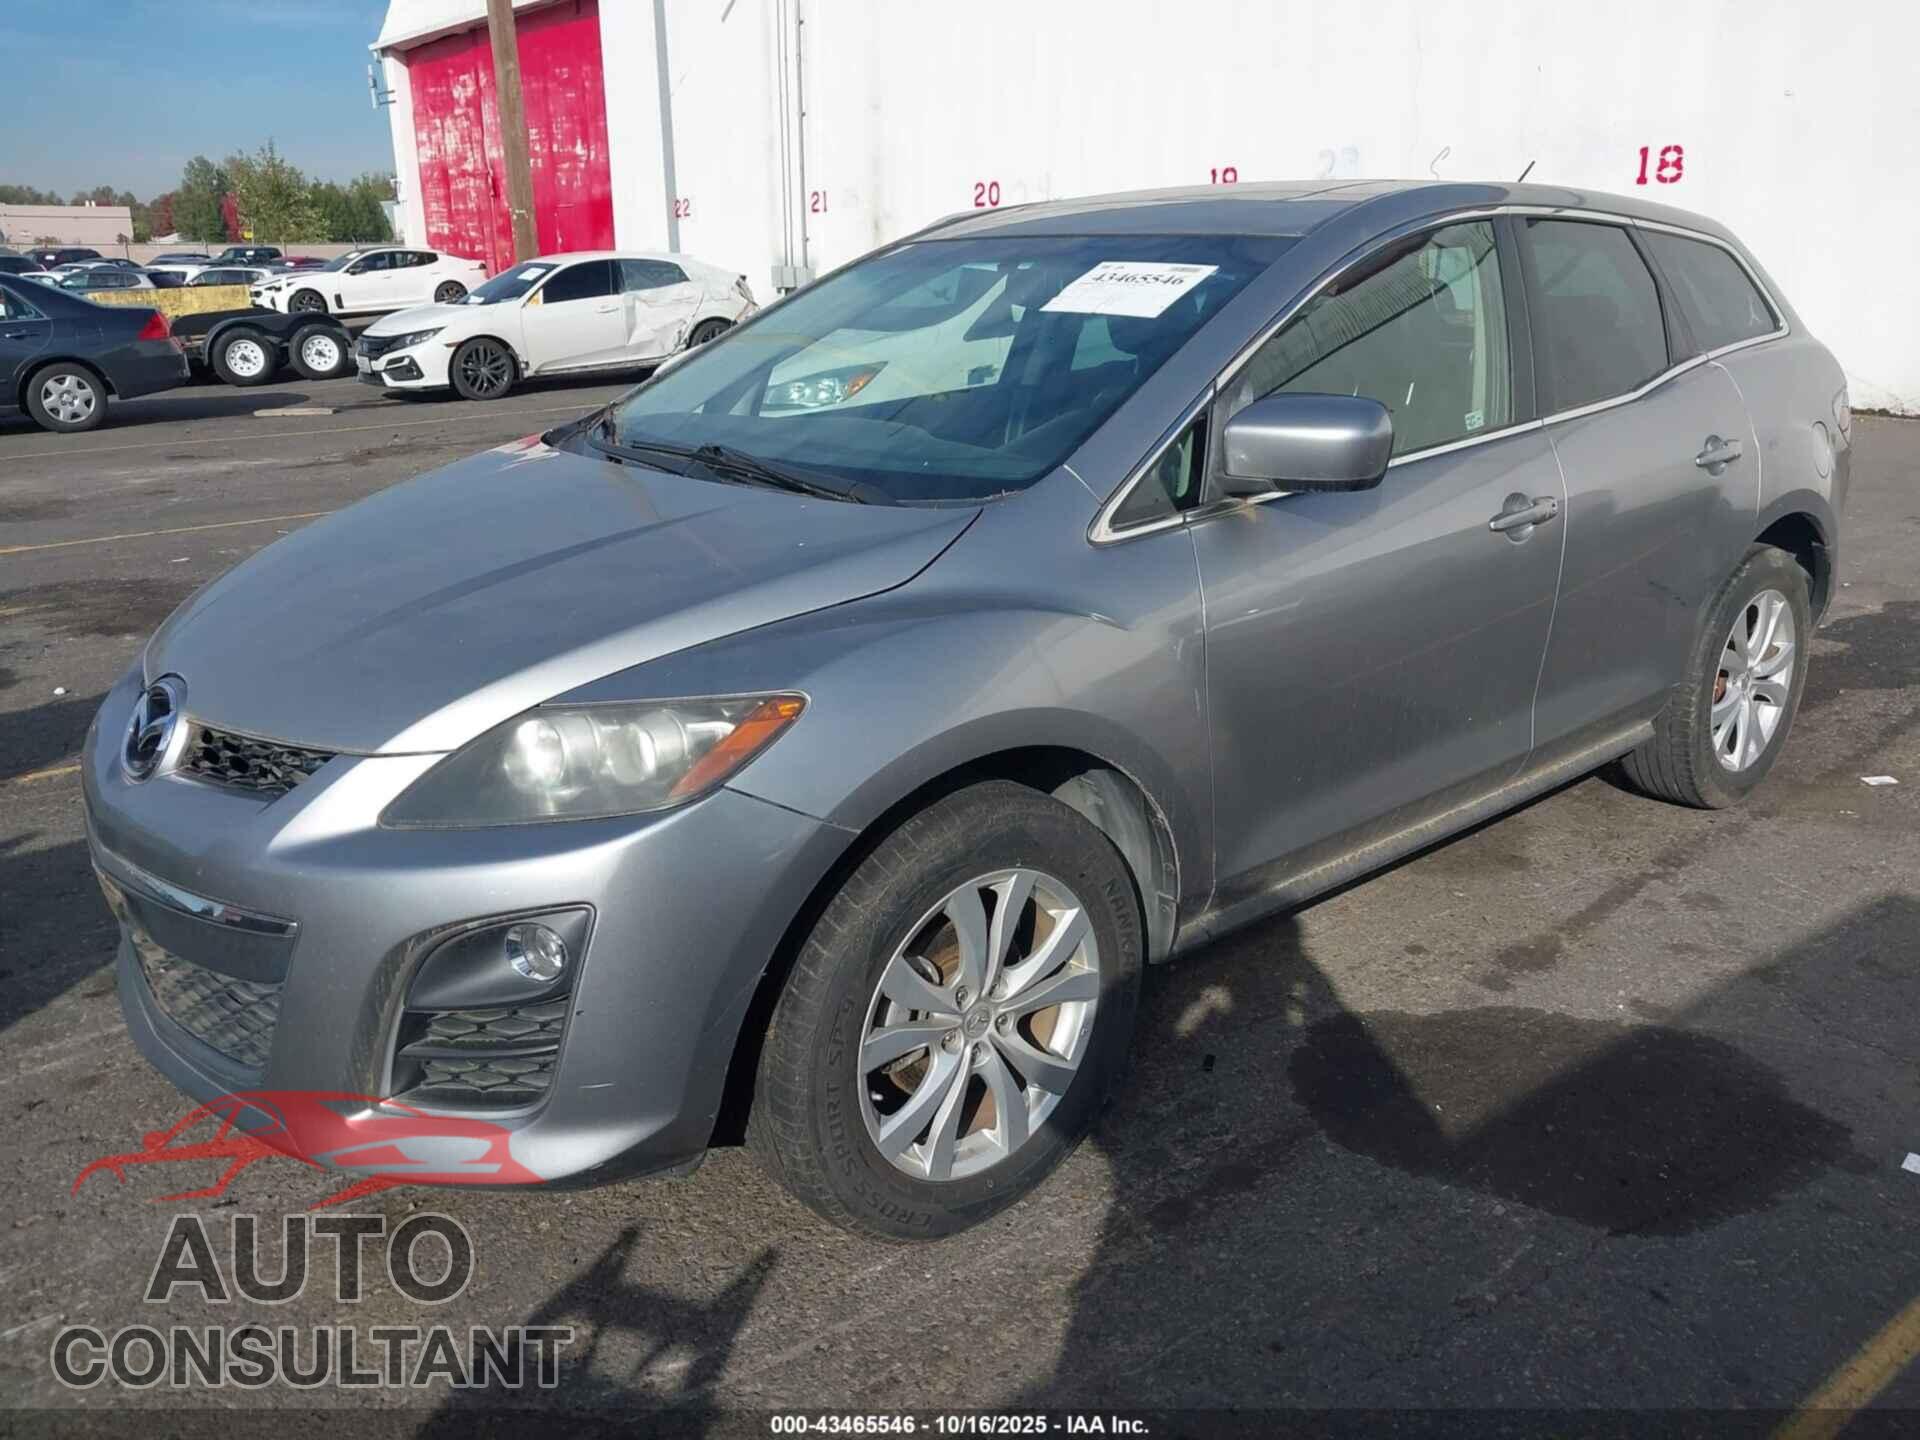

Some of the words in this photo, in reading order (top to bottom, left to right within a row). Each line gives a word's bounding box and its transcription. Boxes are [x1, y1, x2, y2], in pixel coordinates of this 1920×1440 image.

[1636, 145, 1683, 184] 18
[811, 190, 828, 213] 21
[974, 181, 1001, 207] 20
[673, 198, 691, 218] 22
[1092, 272, 1184, 286] 43465546
